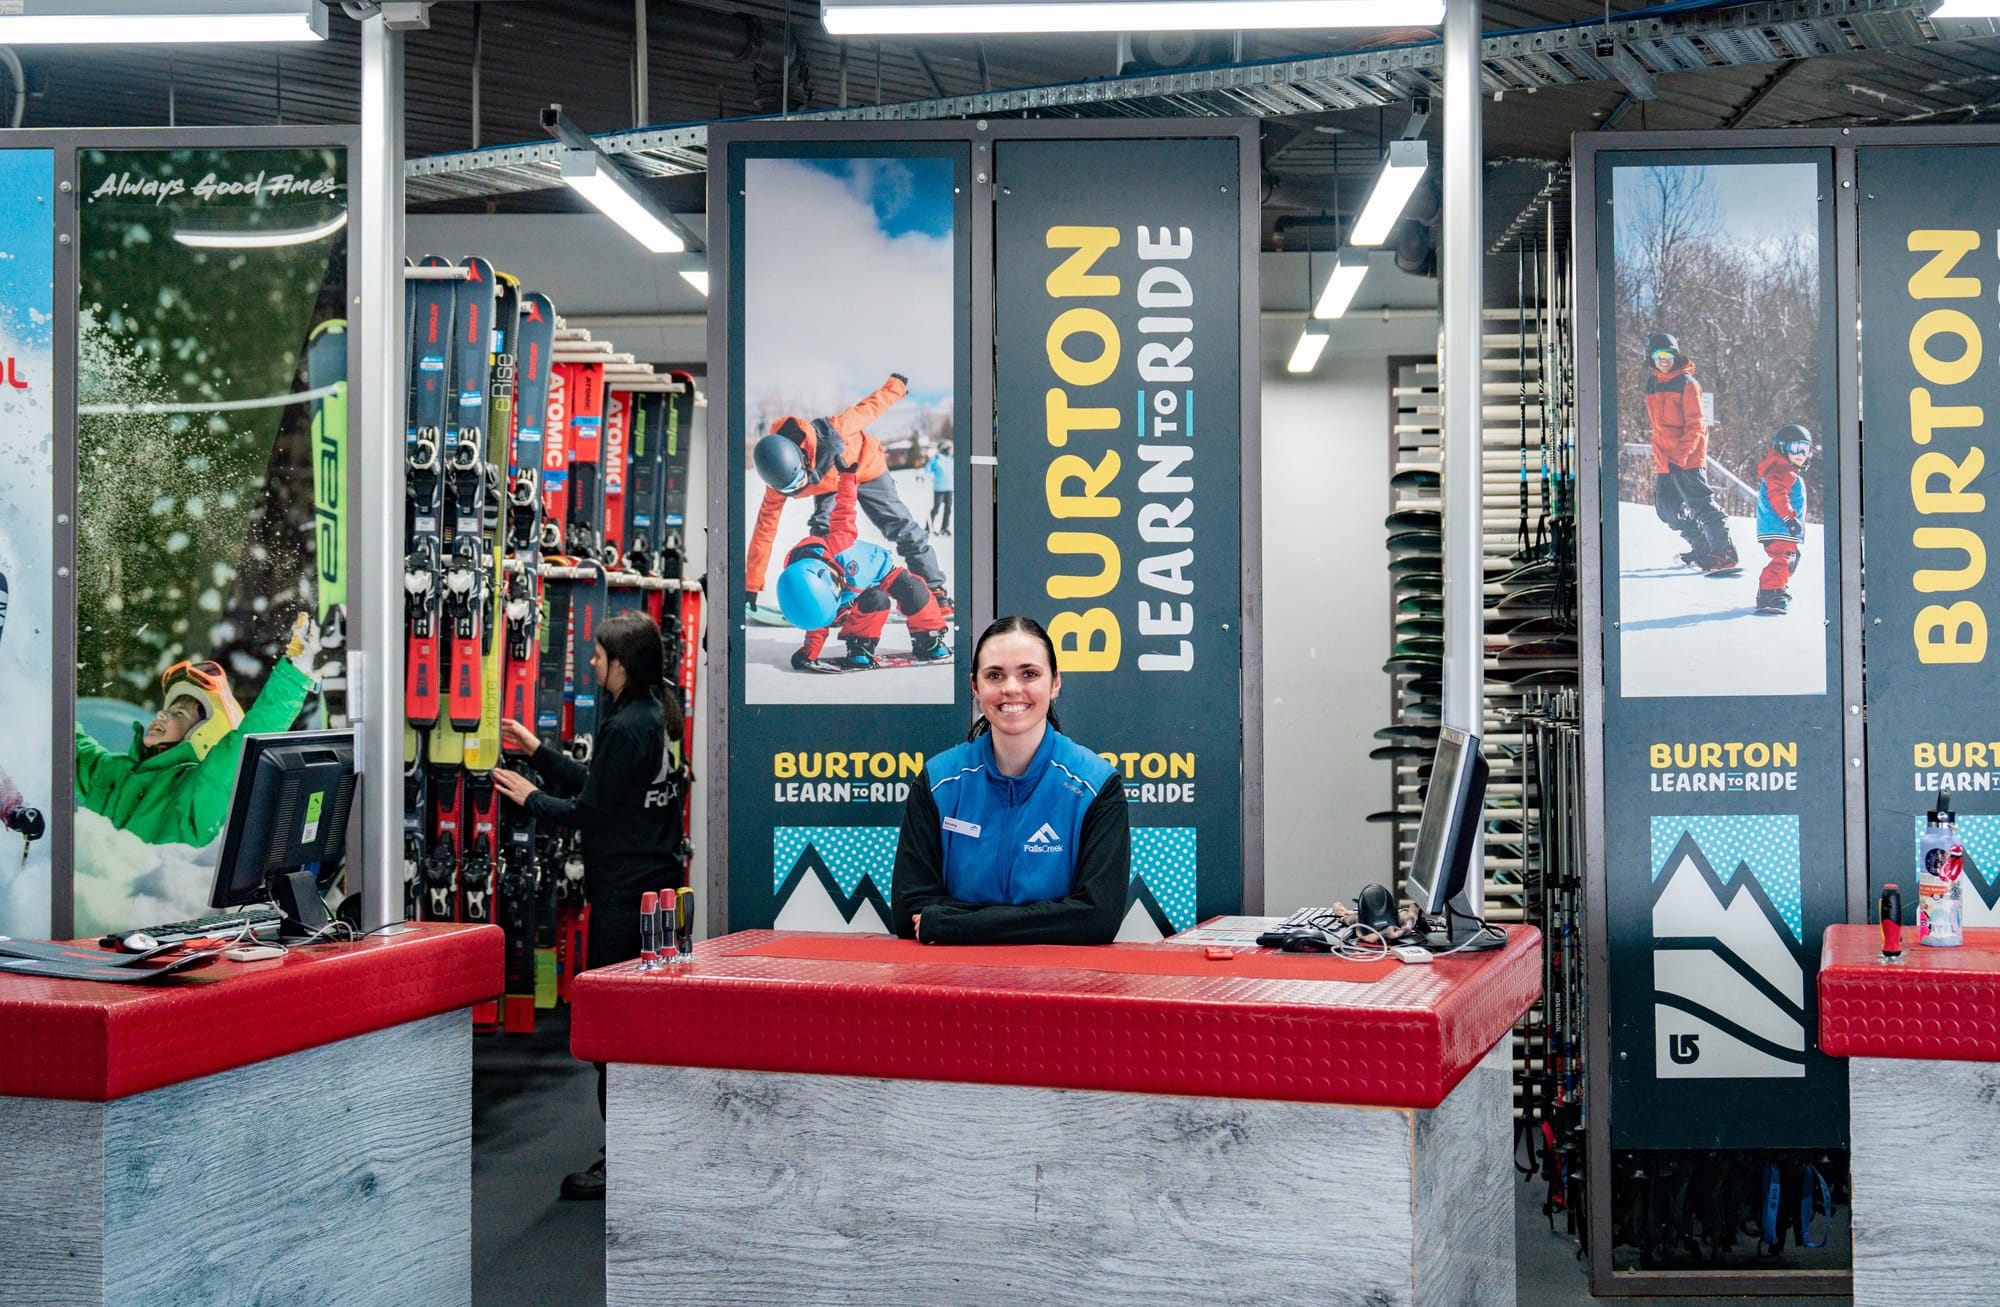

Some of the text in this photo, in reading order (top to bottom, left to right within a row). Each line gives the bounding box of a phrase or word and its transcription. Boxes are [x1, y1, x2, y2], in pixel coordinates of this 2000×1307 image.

[92, 170, 336, 206] Always Good Times
[0, 357, 28, 389] L
[491, 353, 514, 412] eRise
[547, 371, 566, 467] ATOMIC
[1046, 225, 1121, 672] BURTON
[1137, 225, 1194, 672] LEARN TO RIDE
[1907, 229, 1988, 664] BURTON
[774, 752, 924, 779] BURTON
[1650, 742, 1797, 768] BURTON
[1914, 742, 2000, 768] BURT
[775, 782, 911, 802] LEARN TO RID
[1141, 783, 1195, 803] RIDE
[1650, 772, 1798, 792] LEARN TO RIDE
[1914, 771, 1990, 792] LEARN
[1024, 844, 1063, 853] FallsCreek
